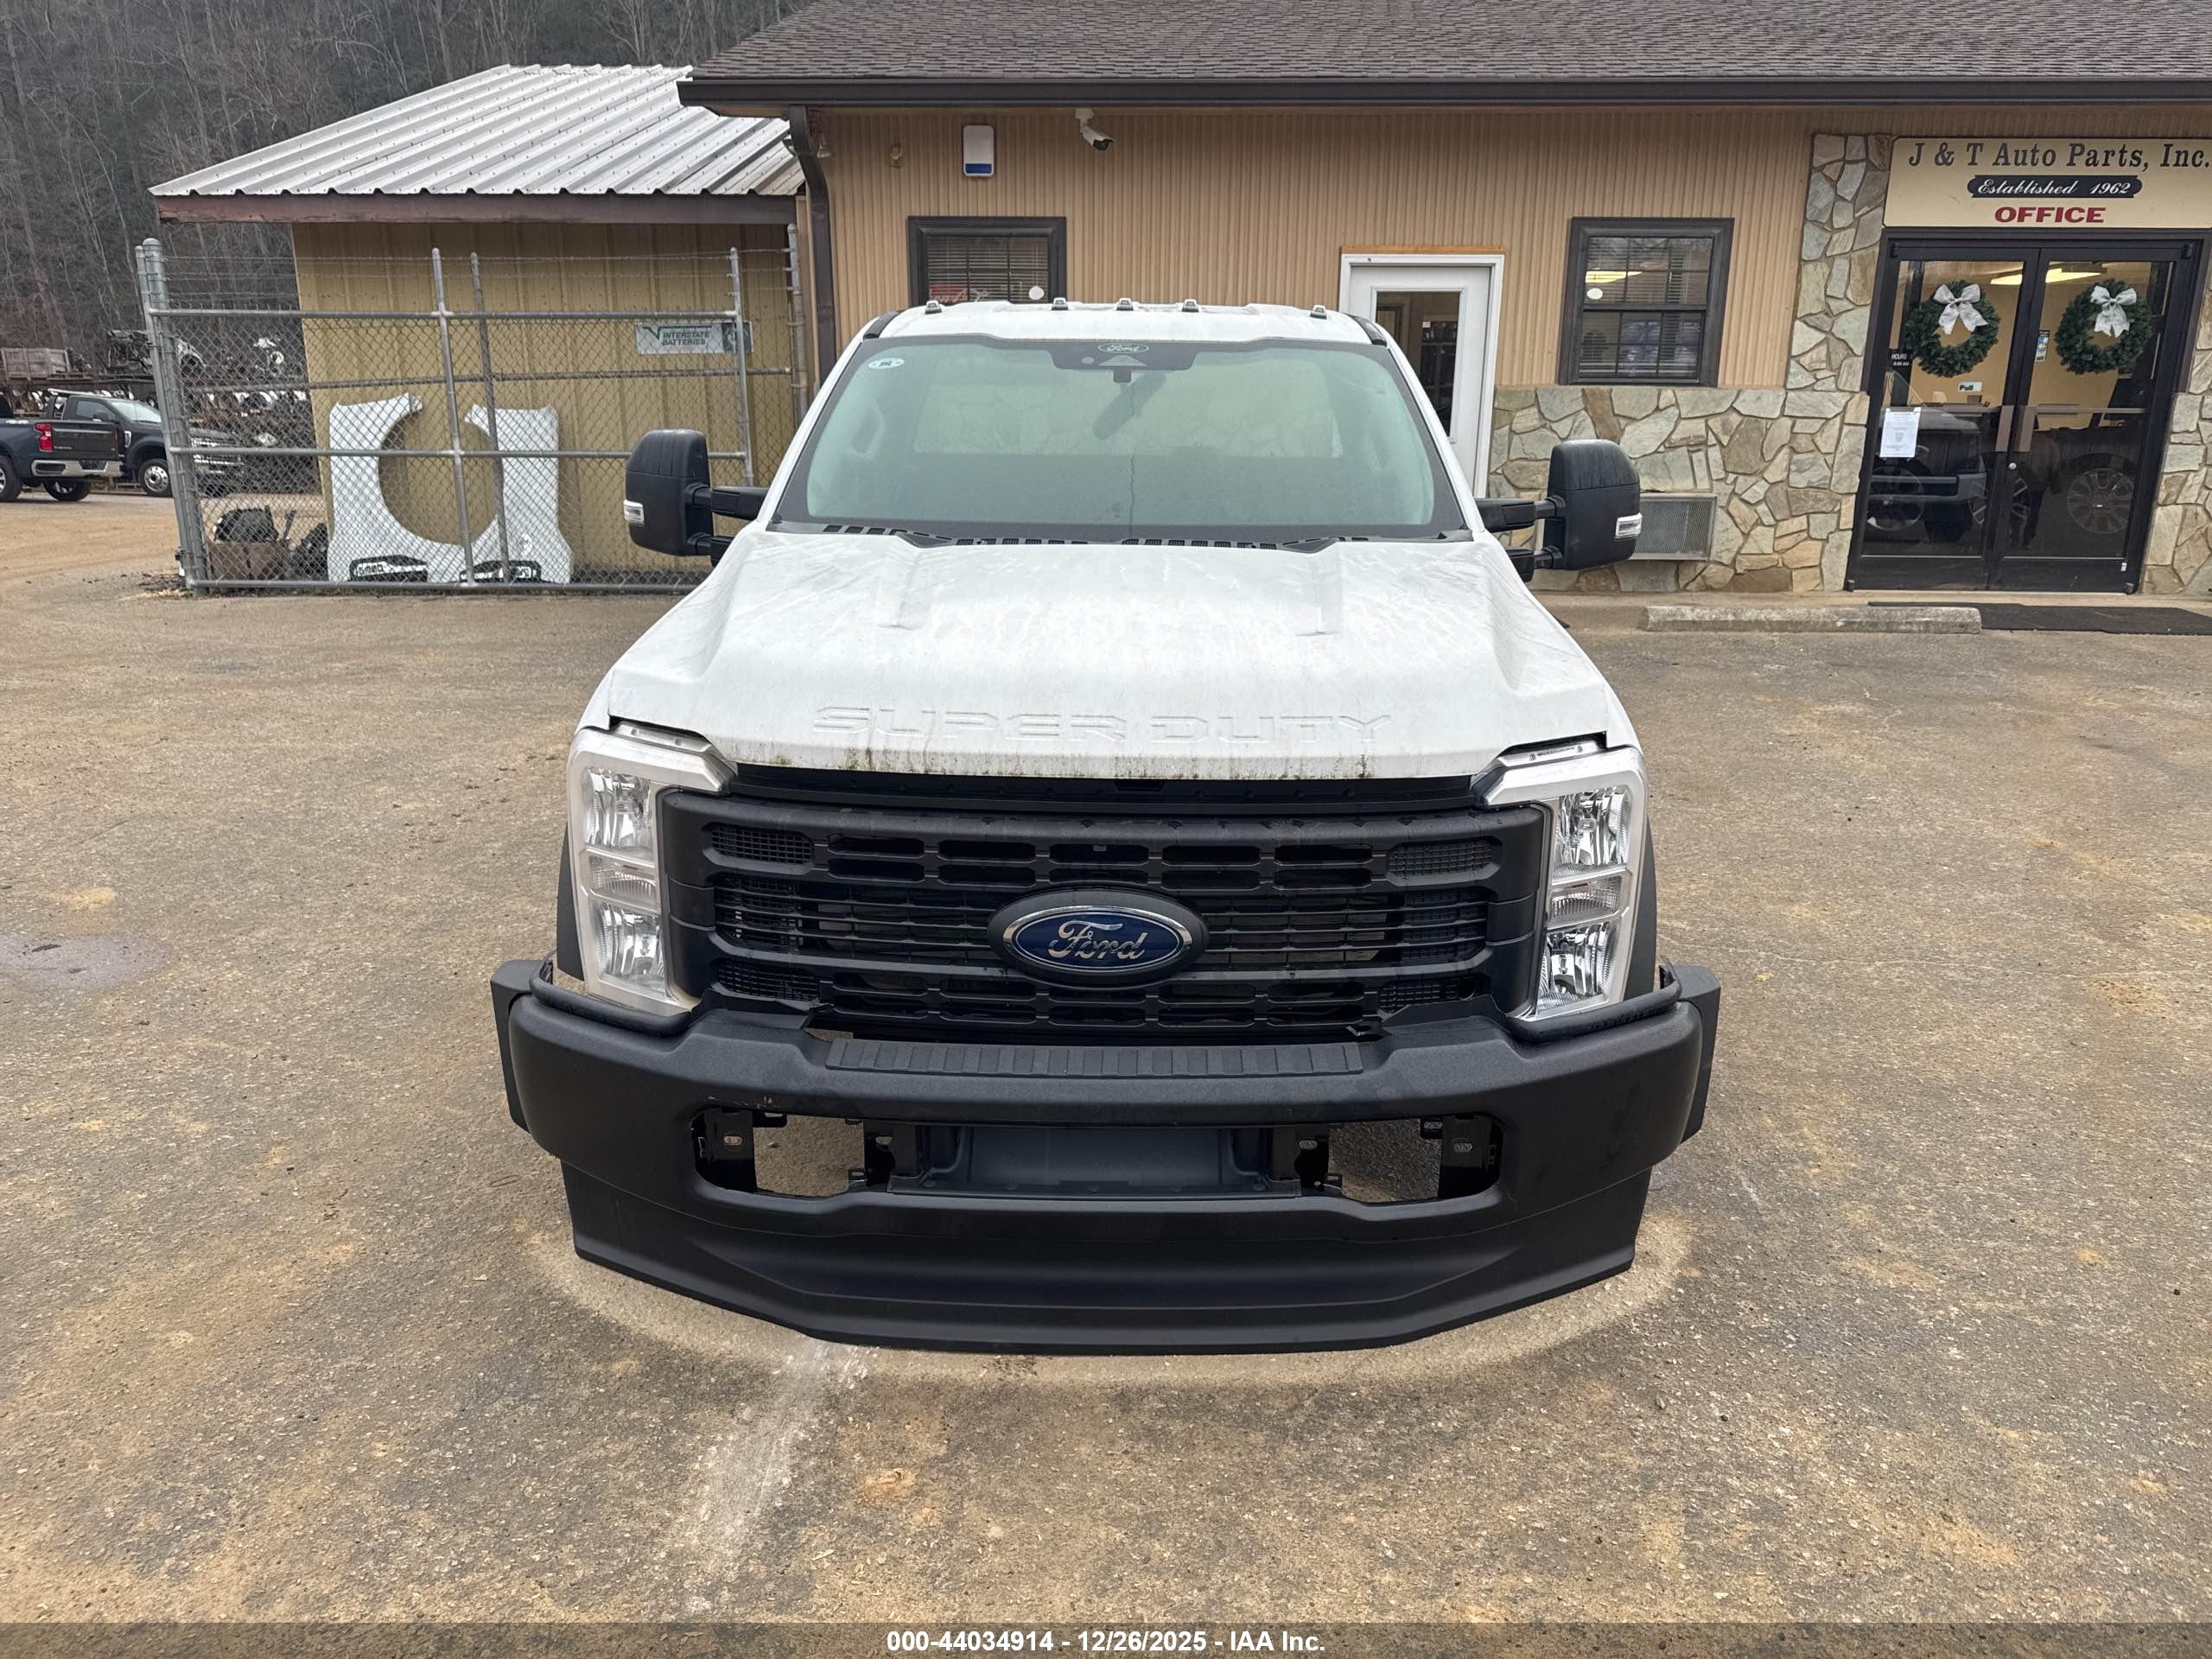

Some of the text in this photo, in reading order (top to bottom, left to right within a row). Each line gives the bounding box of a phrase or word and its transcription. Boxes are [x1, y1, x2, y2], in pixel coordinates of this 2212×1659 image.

[1908, 142, 2209, 172] J & T Auto Parts, Inc.
[1977, 178, 2131, 194] Established 1962
[1994, 207, 2107, 223] OFFICE
[812, 706, 1393, 745] SUPER DUTY
[1048, 919, 1148, 959] Ford
